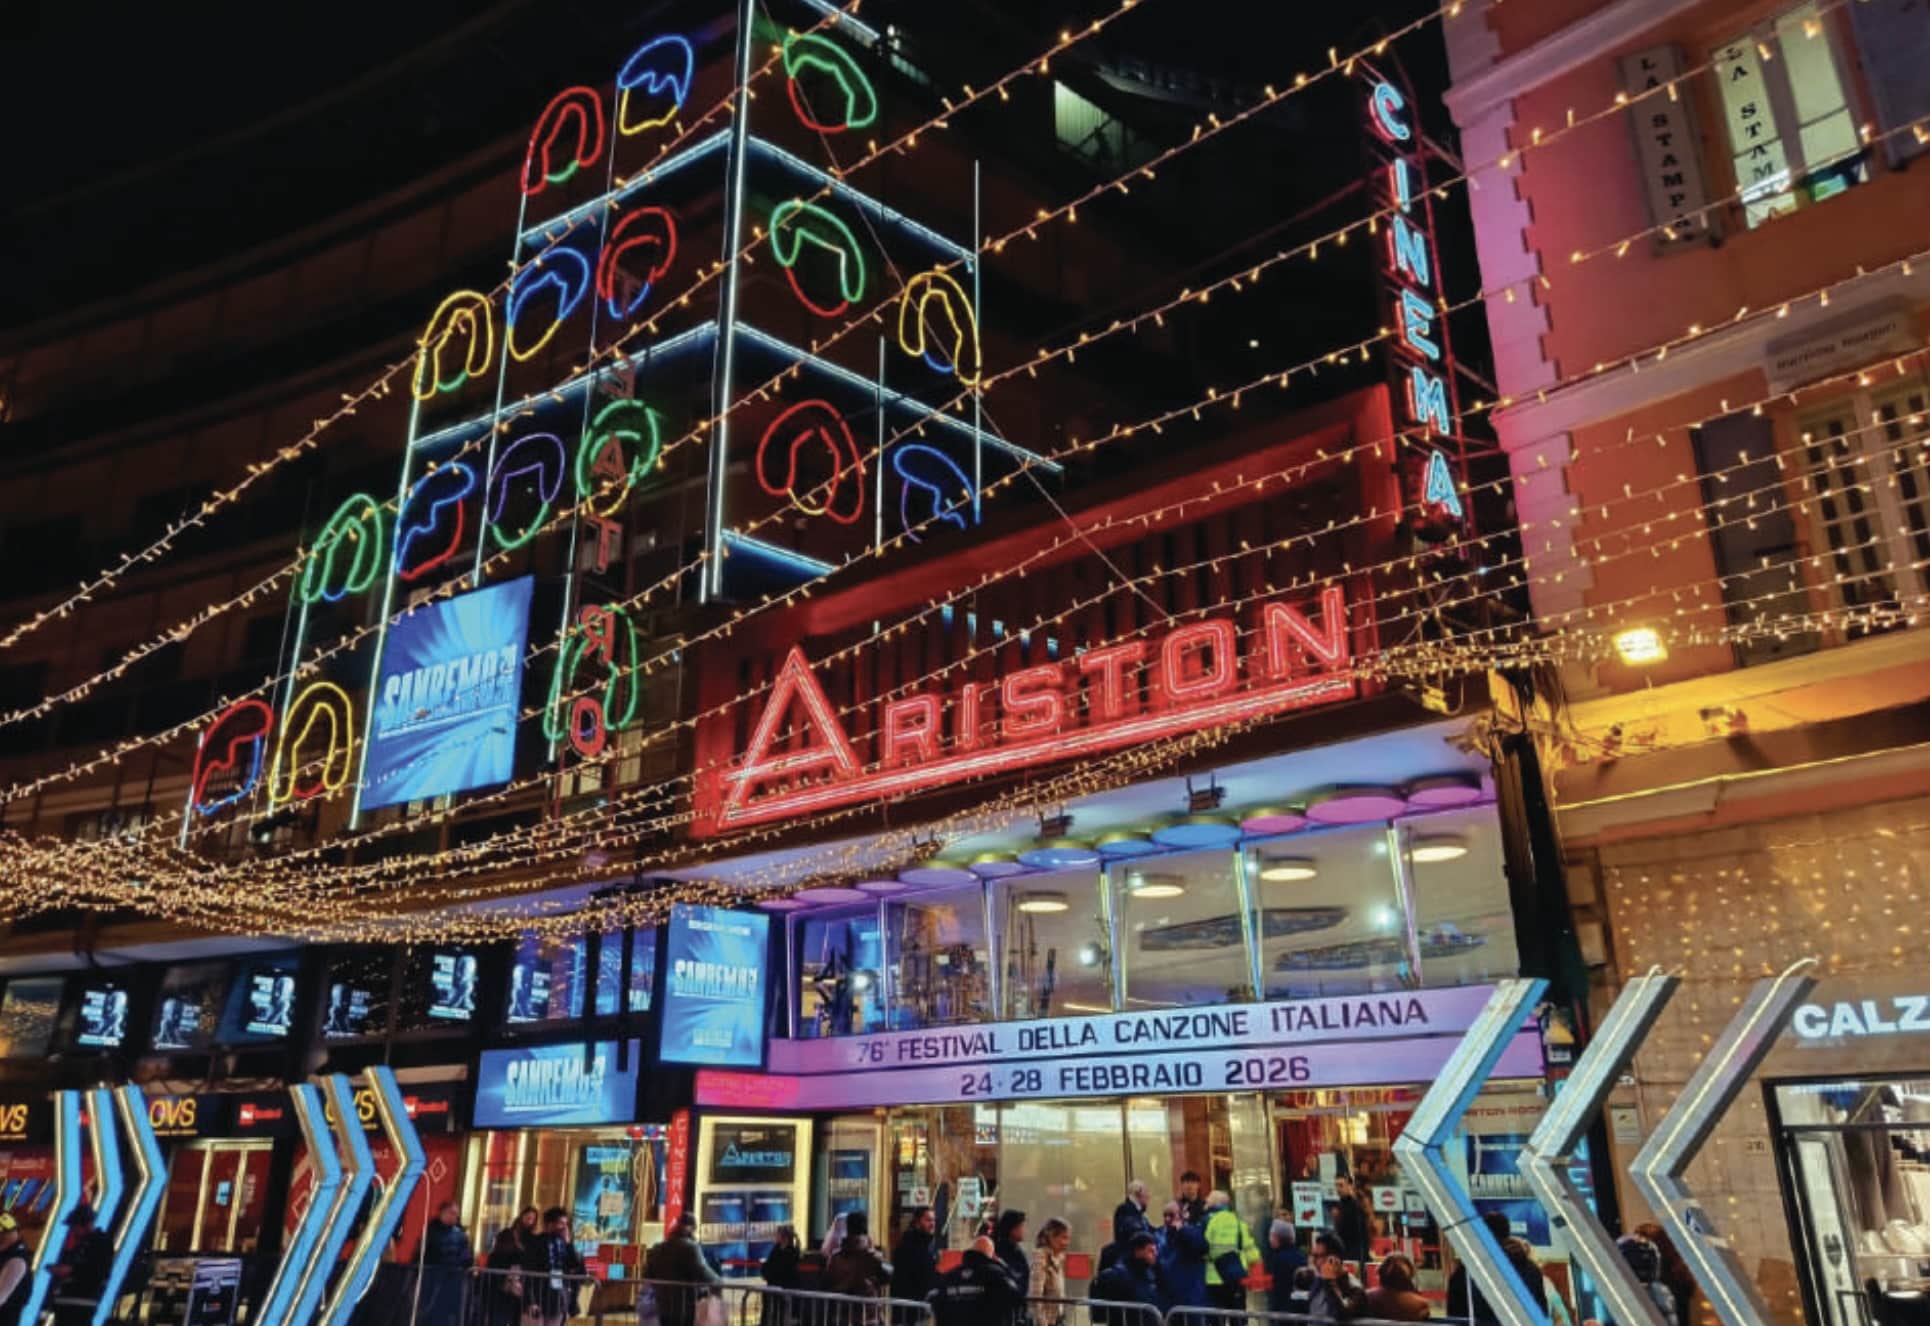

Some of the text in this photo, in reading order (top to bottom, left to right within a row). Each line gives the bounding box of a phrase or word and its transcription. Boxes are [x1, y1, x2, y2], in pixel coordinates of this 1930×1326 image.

[1370, 82, 1463, 518] CINEMA
[718, 584, 1354, 828] ARISTON
[898, 1032, 1002, 1061] FESTIVAL
[1018, 1020, 1099, 1051] DELLA
[1114, 1009, 1249, 1043] CANZONE
[1271, 997, 1428, 1033] ITALIANA
[150, 1098, 197, 1127] OVS
[961, 1072, 993, 1096] 24
[1011, 1069, 1042, 1092] 28
[1060, 1061, 1203, 1090] FEBBRAIO
[1225, 1056, 1311, 1084] 2026
[670, 1117, 688, 1206] CINEMA
